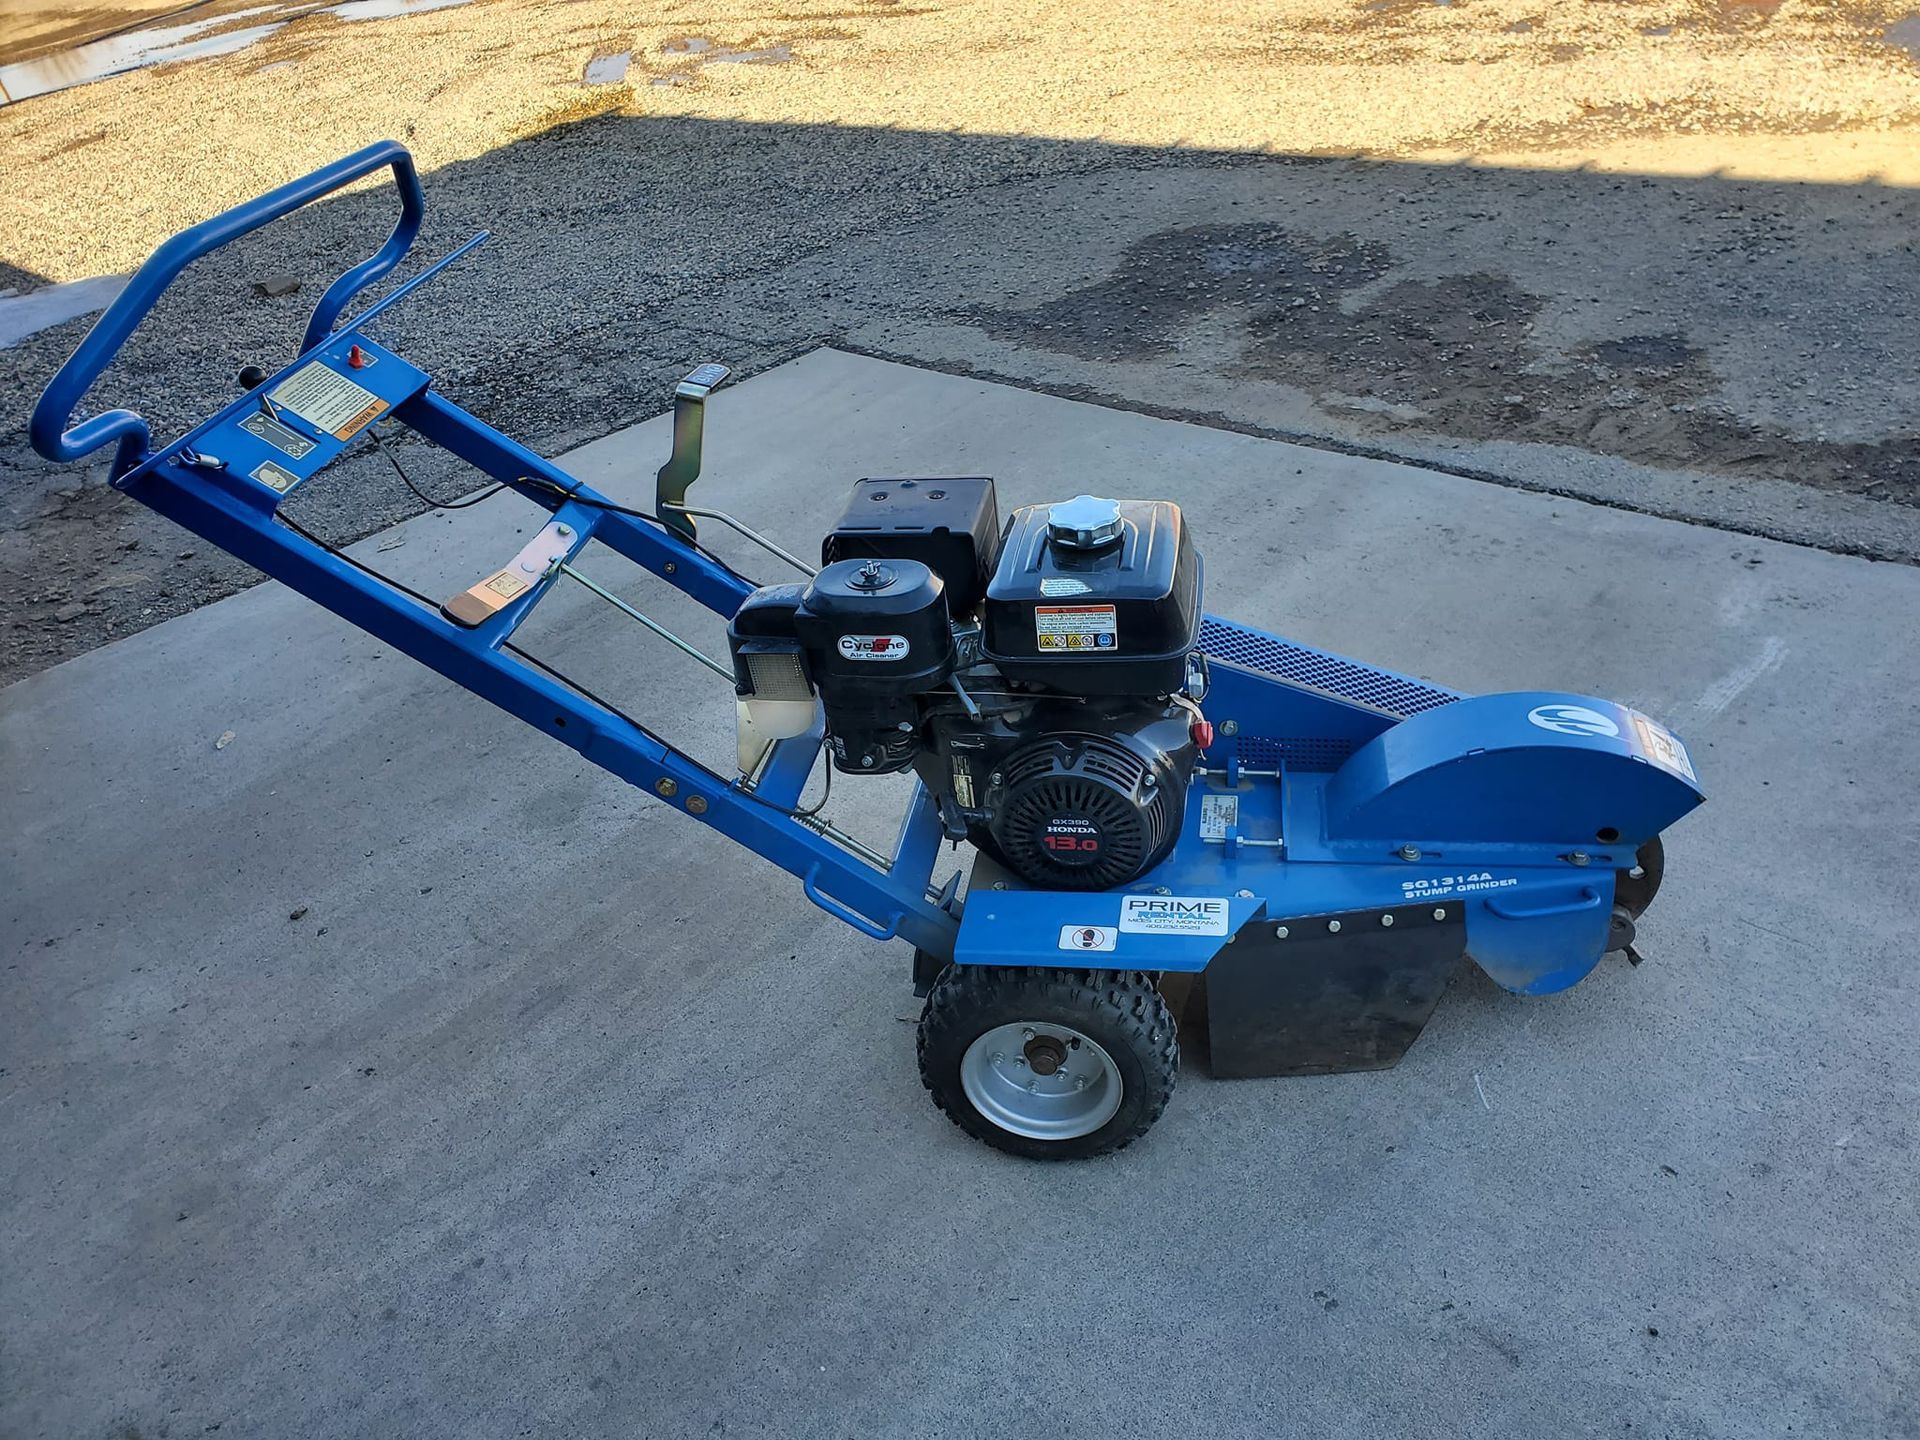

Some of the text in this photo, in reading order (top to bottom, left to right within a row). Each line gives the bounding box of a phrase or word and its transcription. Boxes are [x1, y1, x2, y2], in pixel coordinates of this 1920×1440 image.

[344, 410, 373, 433] WARNING
[841, 640, 905, 652] Cyclone
[1052, 818, 1090, 826] GX390
[1047, 826, 1098, 834] HONDA
[1043, 836, 1098, 851] 13.0
[1402, 872, 1493, 890] SG1314A
[1404, 878, 1518, 899] STUMP GRINDER
[1128, 900, 1222, 913] PRIME
[1138, 911, 1212, 920] RENTAL
